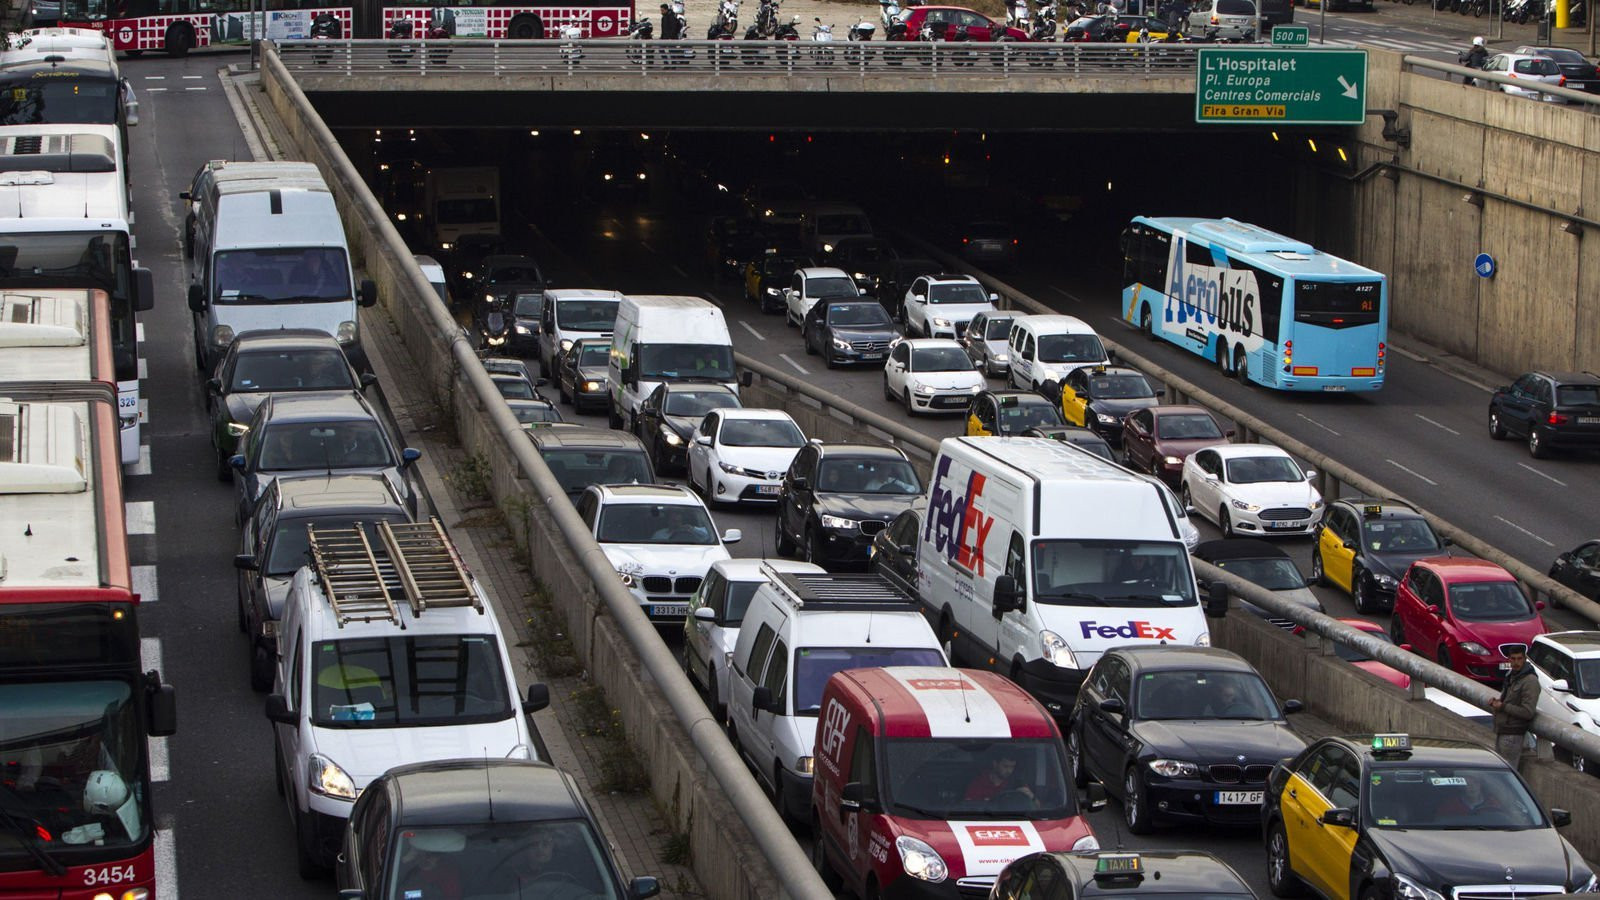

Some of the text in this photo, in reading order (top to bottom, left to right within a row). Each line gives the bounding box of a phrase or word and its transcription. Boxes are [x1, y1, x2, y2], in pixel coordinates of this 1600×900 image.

[1275, 32, 1305, 41] 500 m
[1205, 57, 1297, 74] L'Hospitalet
[1205, 75, 1271, 88] Pl. Europa
[1204, 89, 1321, 102] Centres Comercials
[1204, 106, 1284, 116] Fira Gran Via
[1165, 237, 1254, 338] Aerobús
[120, 397, 136, 407] 326
[924, 454, 994, 578] FedEx
[655, 606, 689, 615] 3313 HH
[1079, 621, 1177, 640] FedEx
[1383, 737, 1399, 747] TAXI
[1222, 792, 1263, 802] 1417 GF
[1109, 859, 1128, 870] TAXI
[83, 864, 136, 886] 3454
